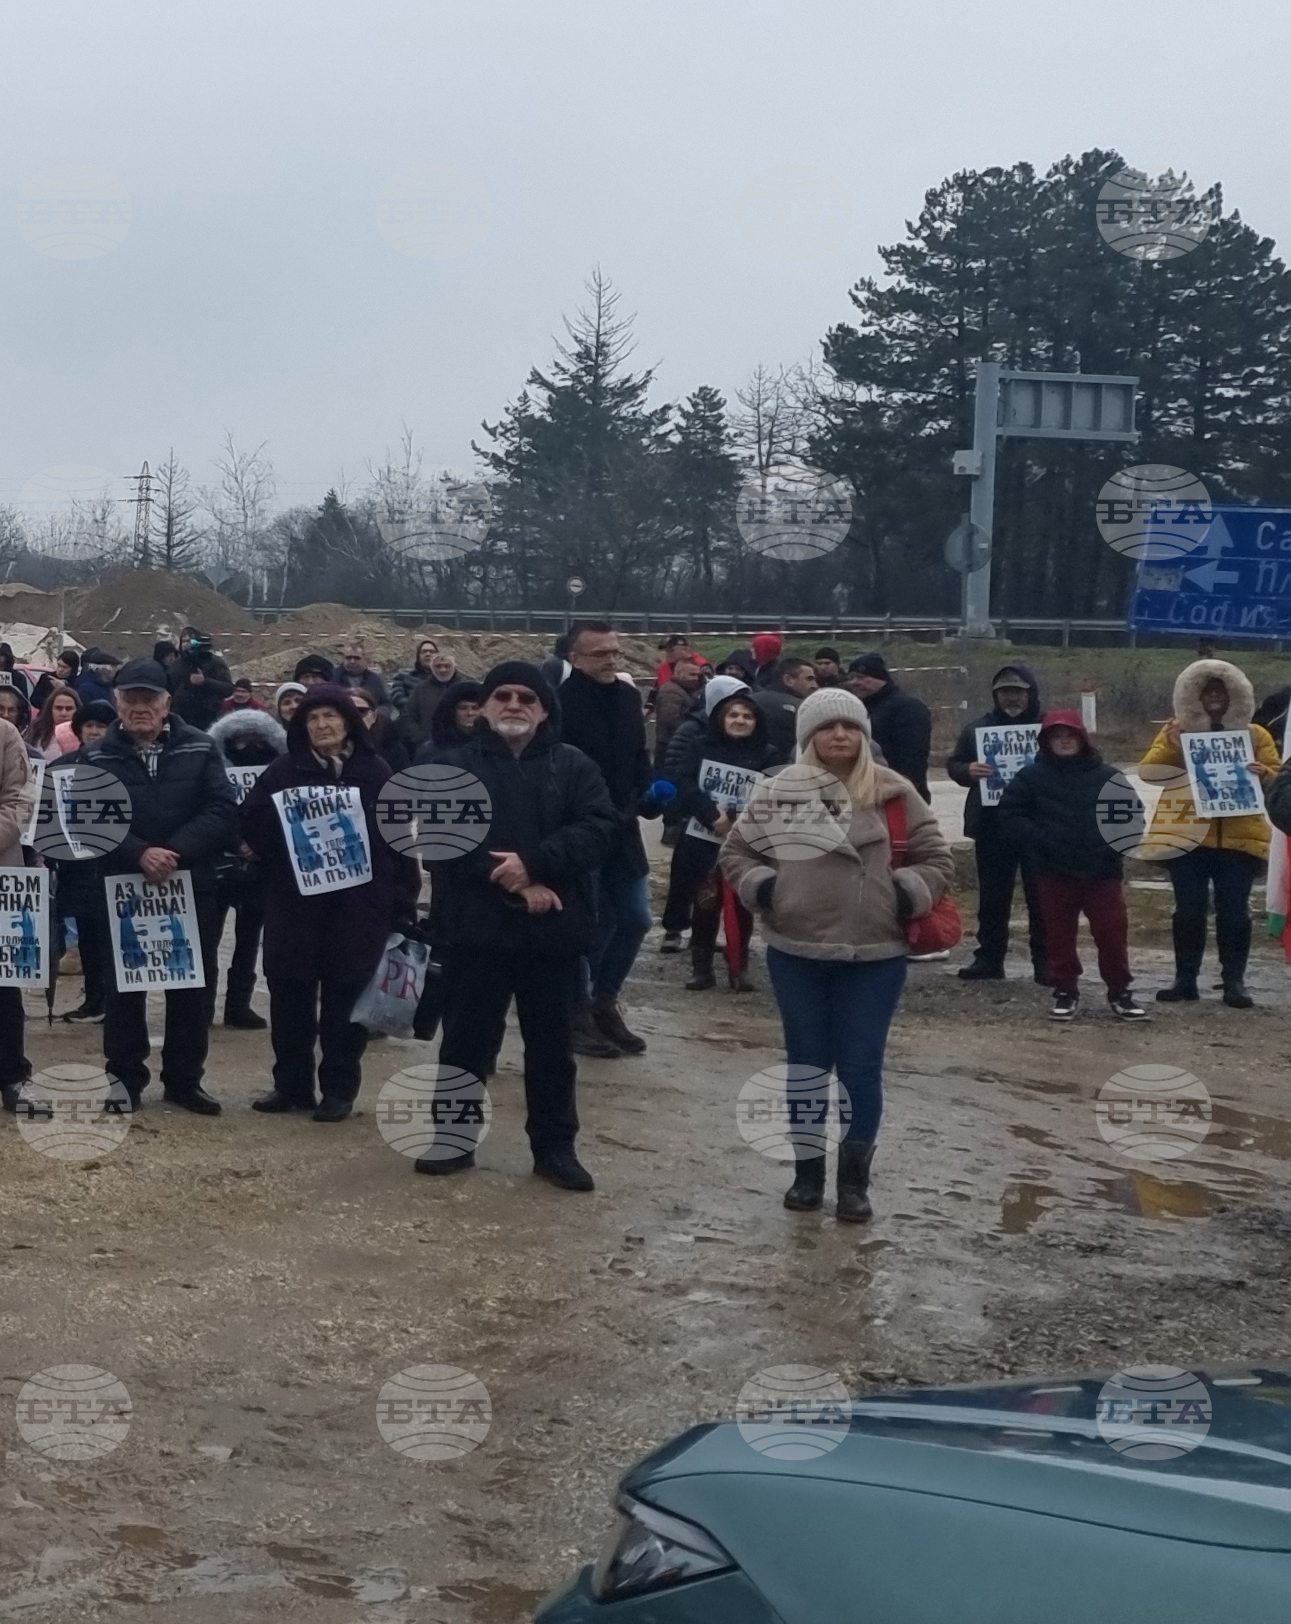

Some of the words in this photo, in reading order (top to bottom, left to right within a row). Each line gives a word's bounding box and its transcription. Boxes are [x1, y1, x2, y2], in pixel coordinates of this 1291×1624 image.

[983, 732, 999, 743] АЗ
[1004, 730, 1037, 742] СЪМ
[1190, 739, 1205, 751] АЗ
[1211, 736, 1245, 750] СЪМ
[1191, 750, 1248, 765] СИЯНА!
[707, 766, 721, 777] АЗ
[282, 788, 301, 806] АЗ
[308, 785, 350, 799] СЪМ
[285, 793, 354, 825] СИЯНА!
[0, 874, 40, 893] СЪМ
[302, 873, 321, 888] НА
[115, 882, 135, 900] АЗ
[142, 879, 185, 898] СЪМ
[116, 897, 187, 919] СИЯНА!
[125, 970, 143, 984] НА
